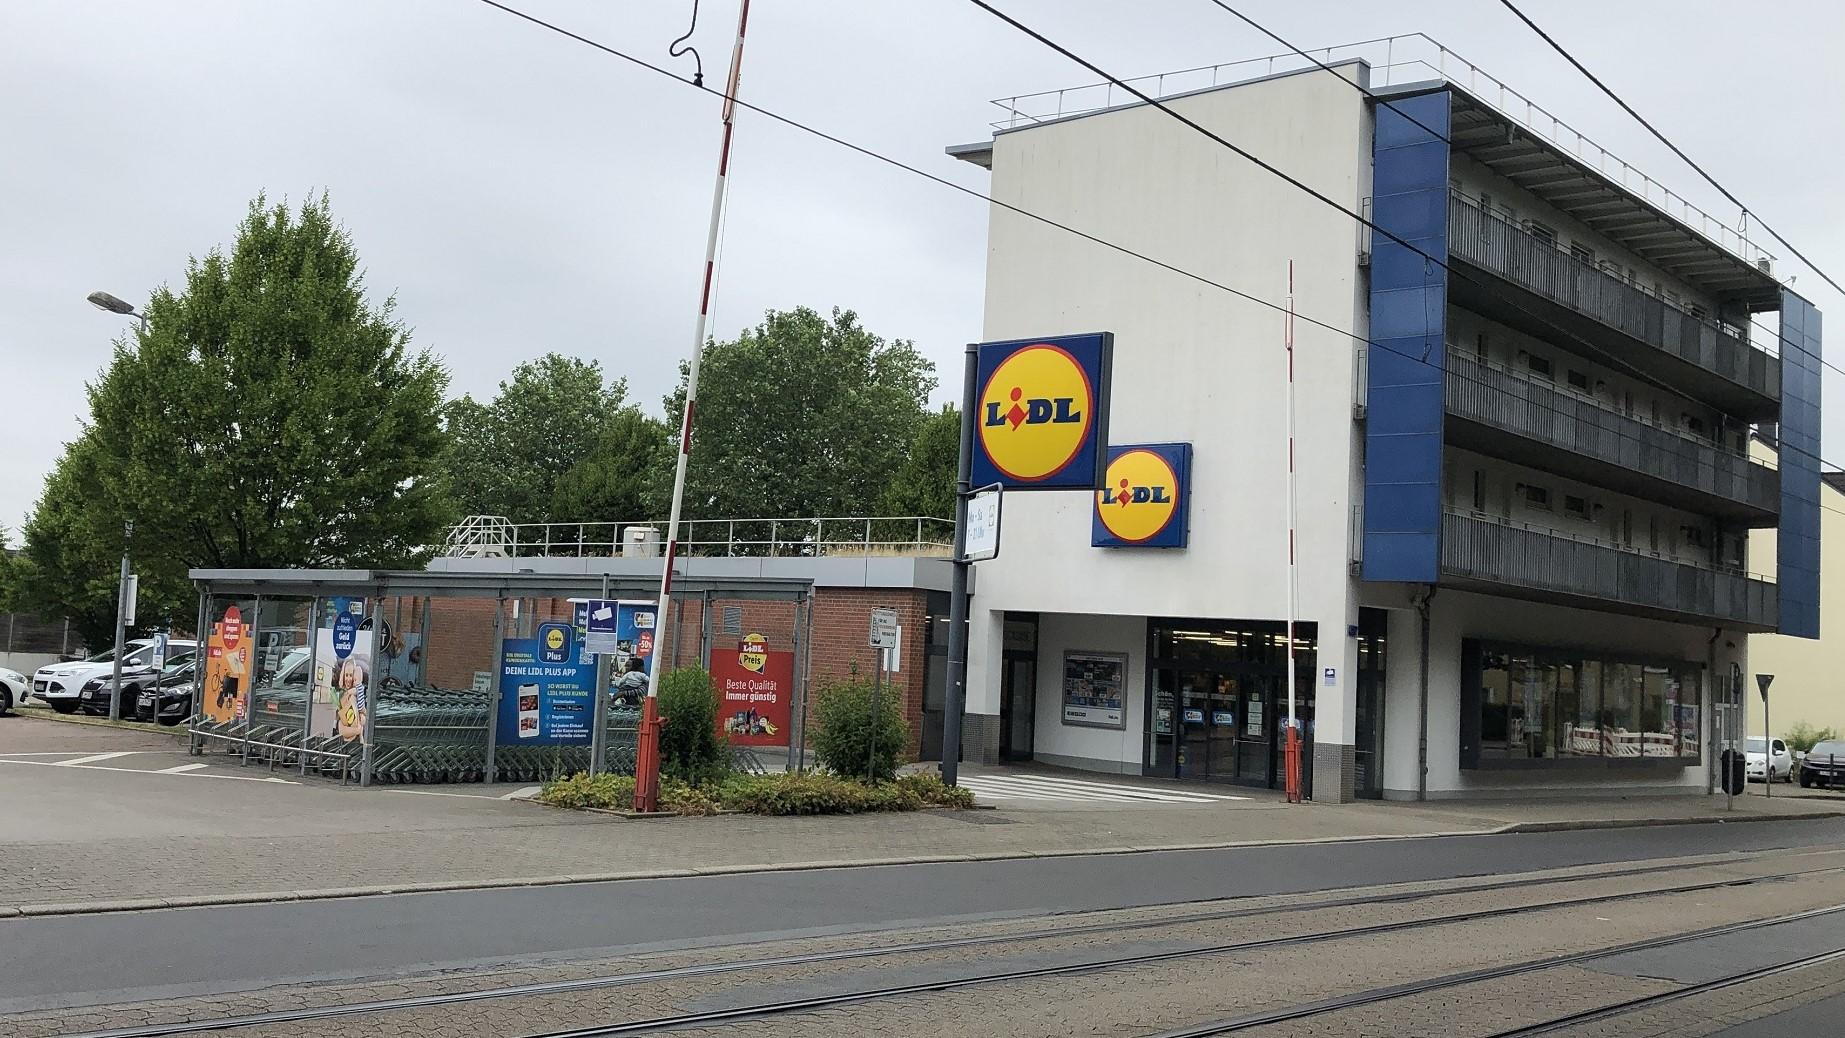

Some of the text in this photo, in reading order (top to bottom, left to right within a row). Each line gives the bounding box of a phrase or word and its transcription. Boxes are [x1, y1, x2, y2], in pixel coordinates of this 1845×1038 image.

[338, 632, 350, 641] Geld
[336, 642, 351, 650] zurück
[547, 652, 561, 661] Plus
[743, 655, 761, 665] Preis
[505, 667, 577, 676] DEINE LIDL PLUS APP
[726, 679, 777, 692] Beste Qualität
[725, 690, 777, 704] Immer günstig
